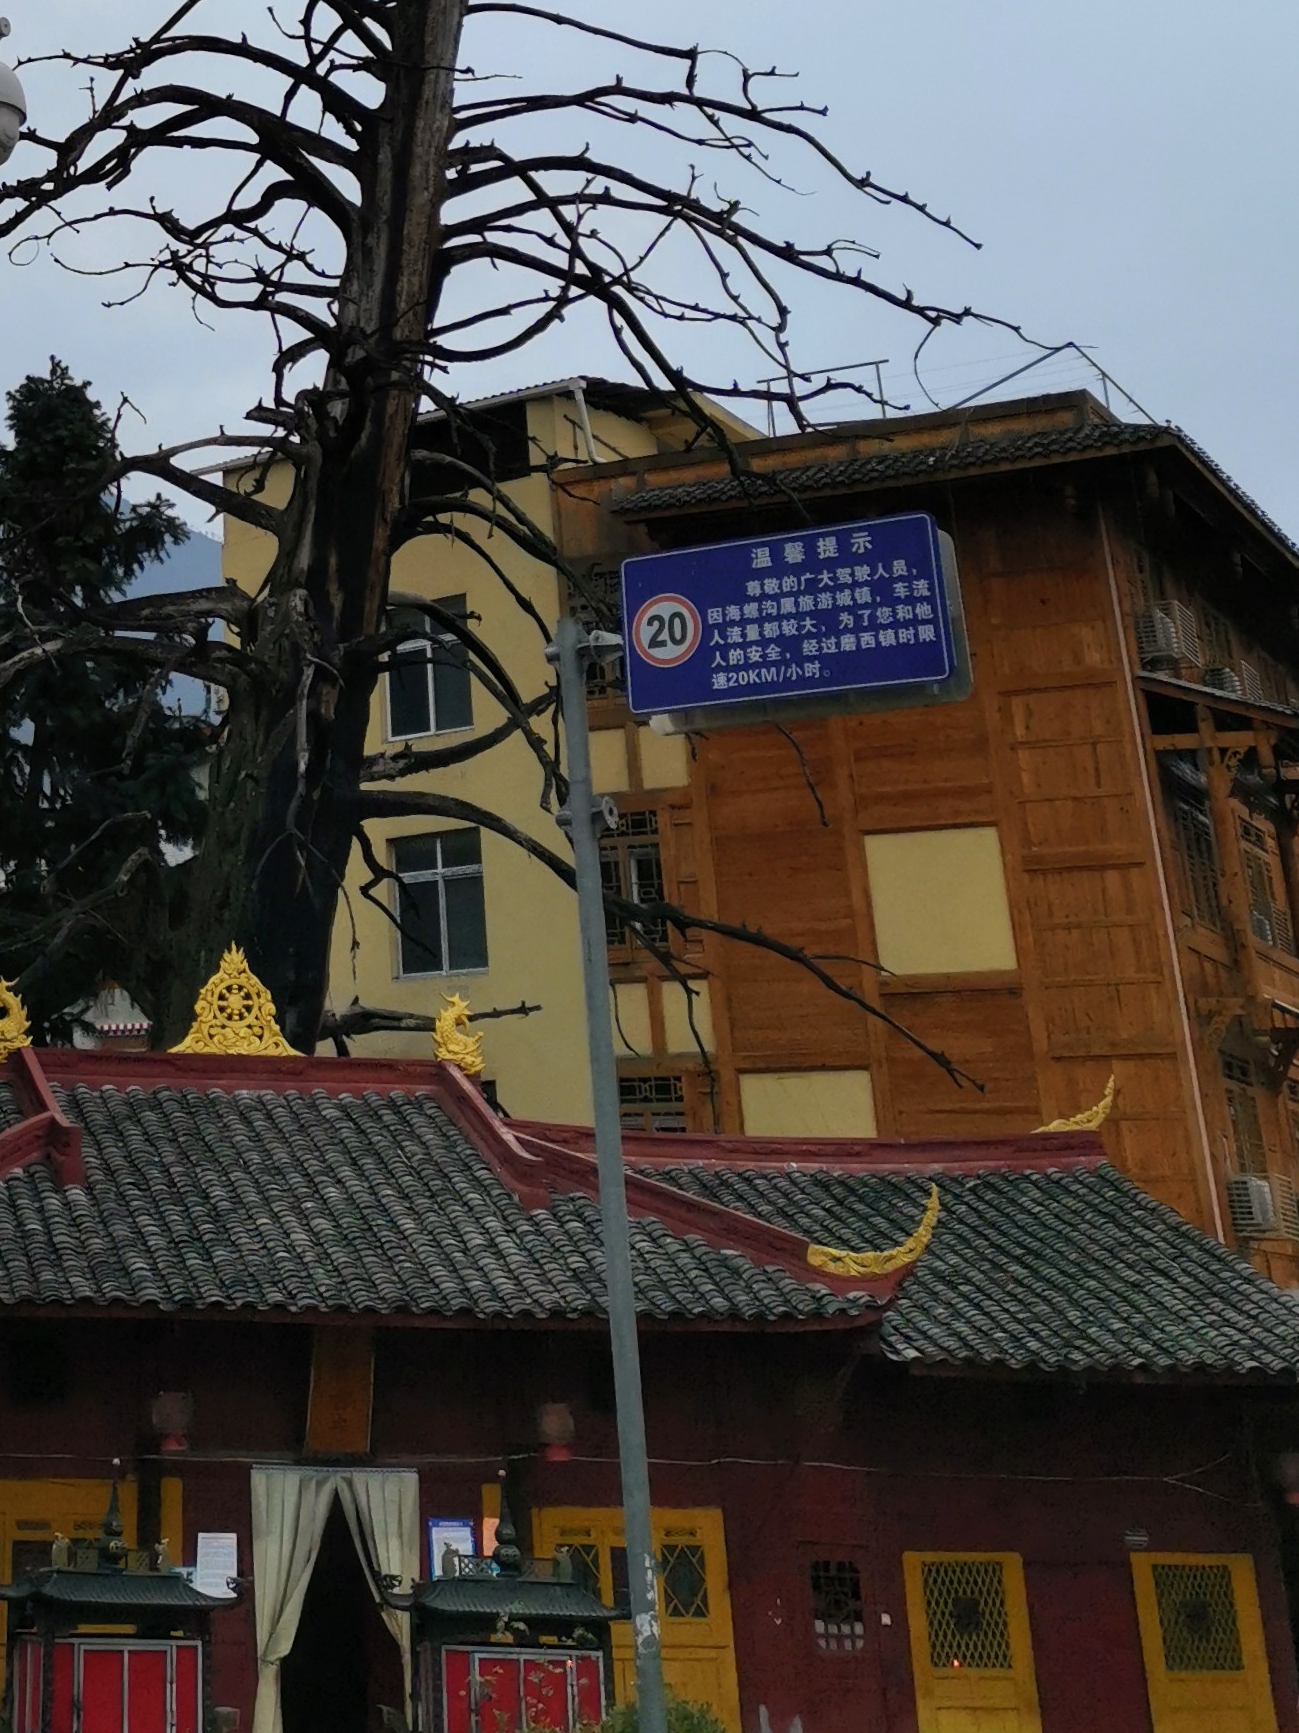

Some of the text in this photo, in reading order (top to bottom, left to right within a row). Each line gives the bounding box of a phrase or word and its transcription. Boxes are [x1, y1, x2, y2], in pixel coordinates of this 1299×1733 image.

[751, 531, 874, 569] 温馨提示
[745, 559, 918, 598] 尊敬的广大驾驶人员，
[646, 610, 688, 650] 20
